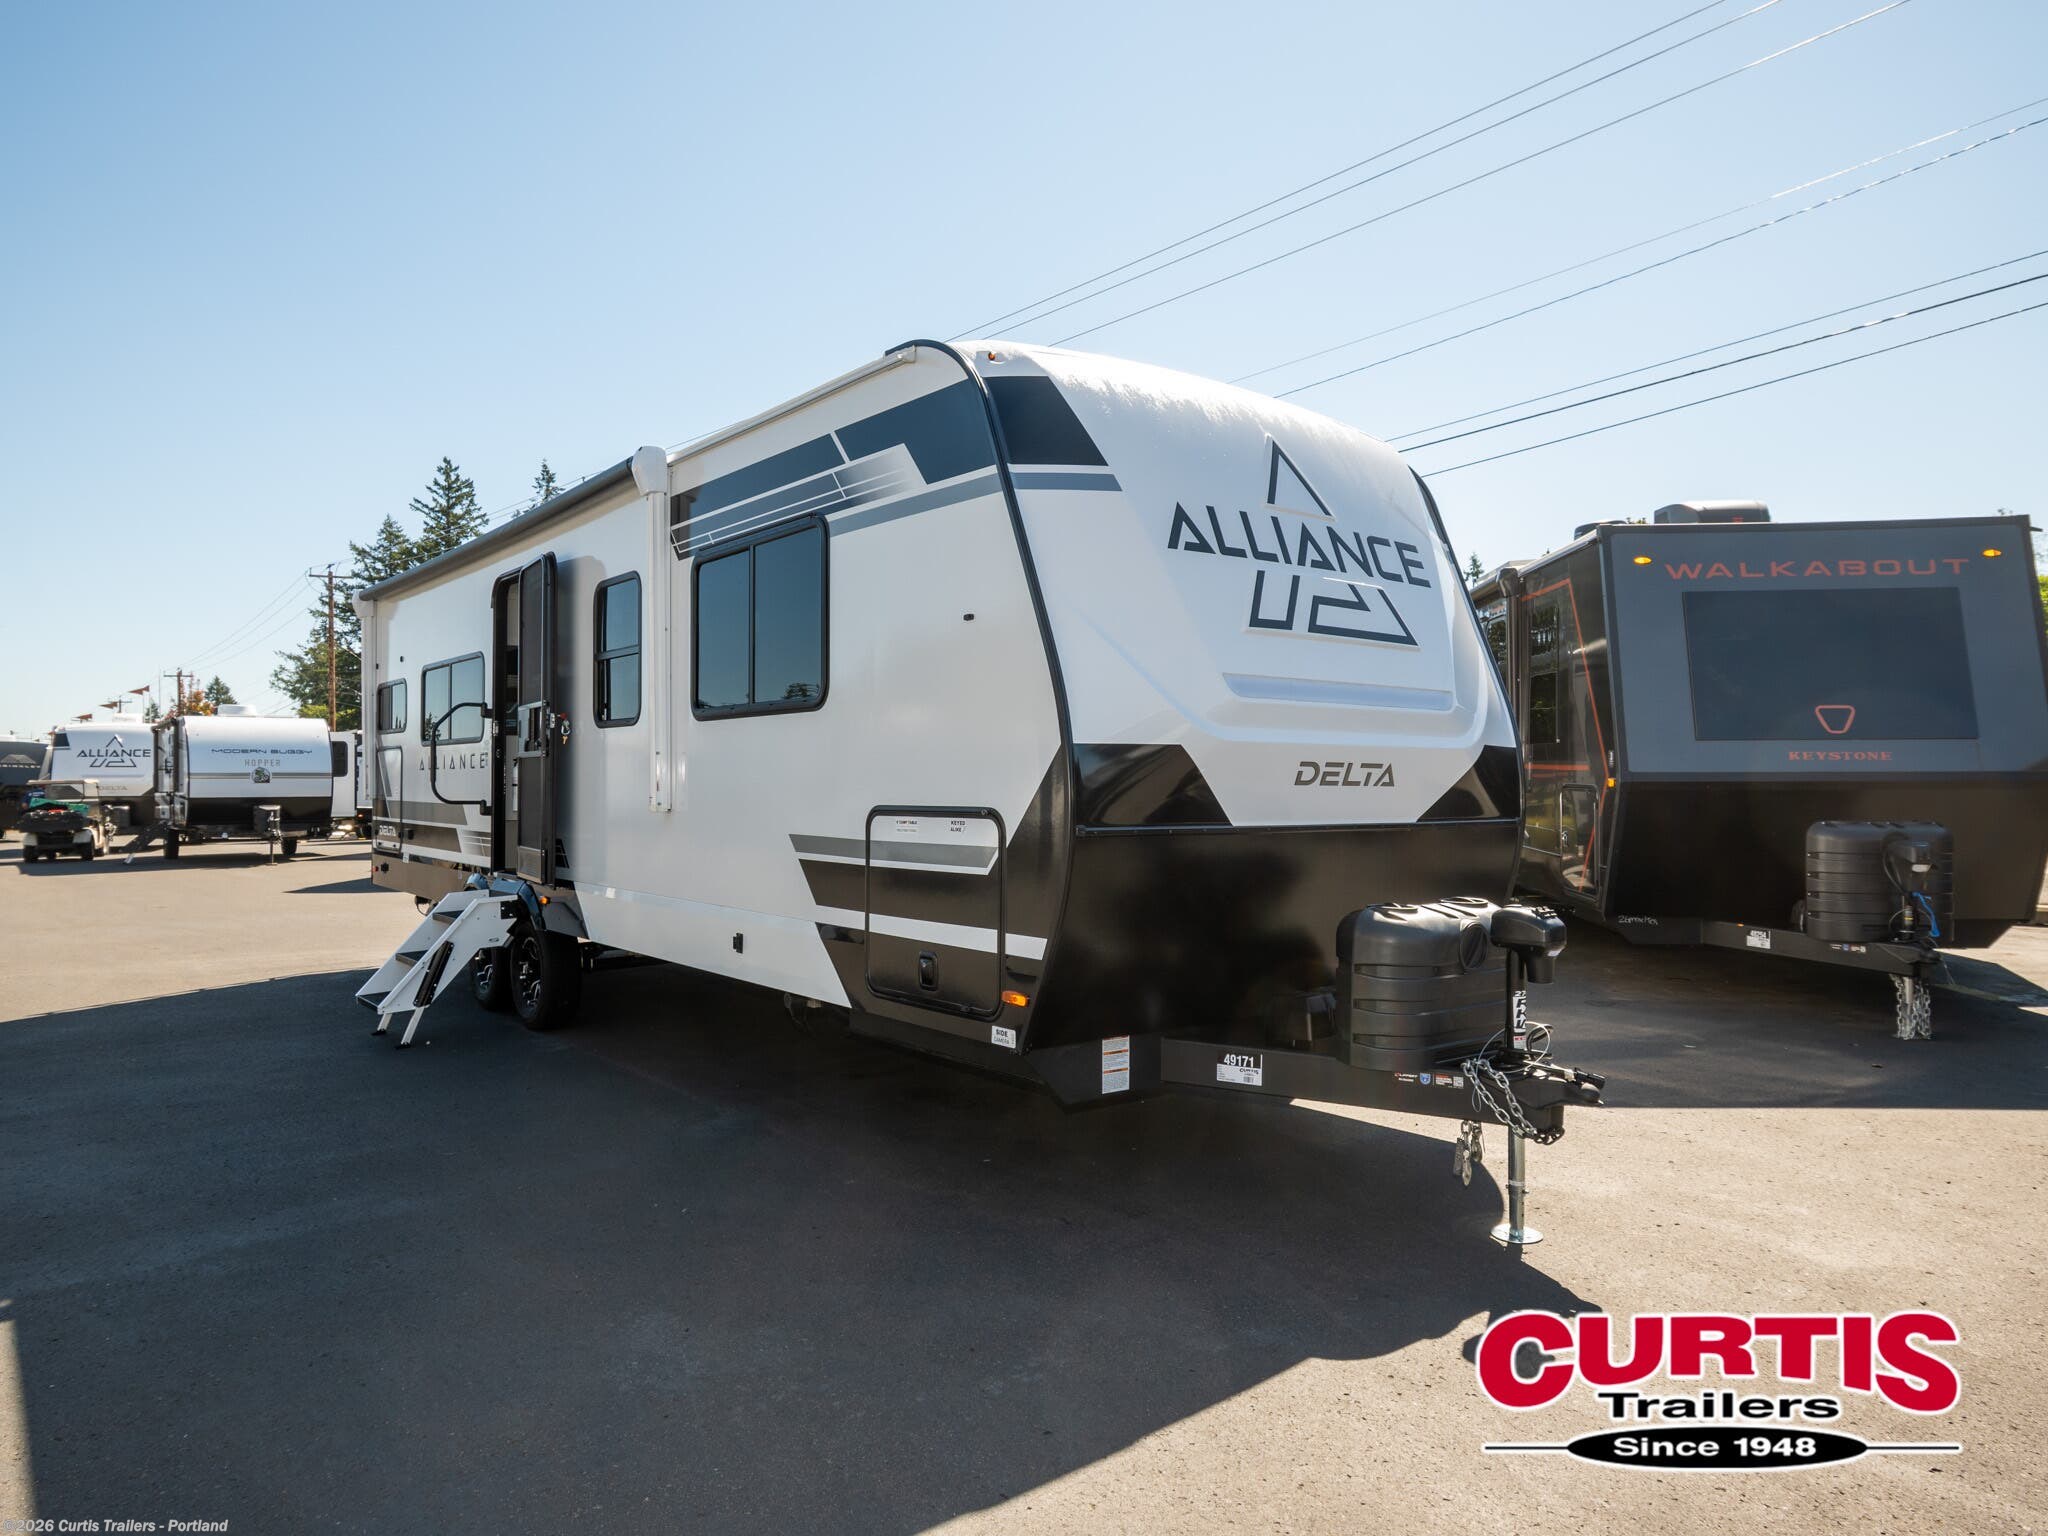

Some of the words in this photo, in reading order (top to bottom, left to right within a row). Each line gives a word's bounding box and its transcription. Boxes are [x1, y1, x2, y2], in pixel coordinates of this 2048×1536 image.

[1167, 501, 1432, 588] ALLIANCE
[1664, 558, 1969, 580] WALKABOUT
[77, 749, 151, 758] ALLIANCE
[1788, 751, 1893, 761] KEYSTONE
[244, 759, 281, 767] HOPPER
[1294, 761, 1395, 787] DELTA
[1224, 1053, 1254, 1068] 49171
